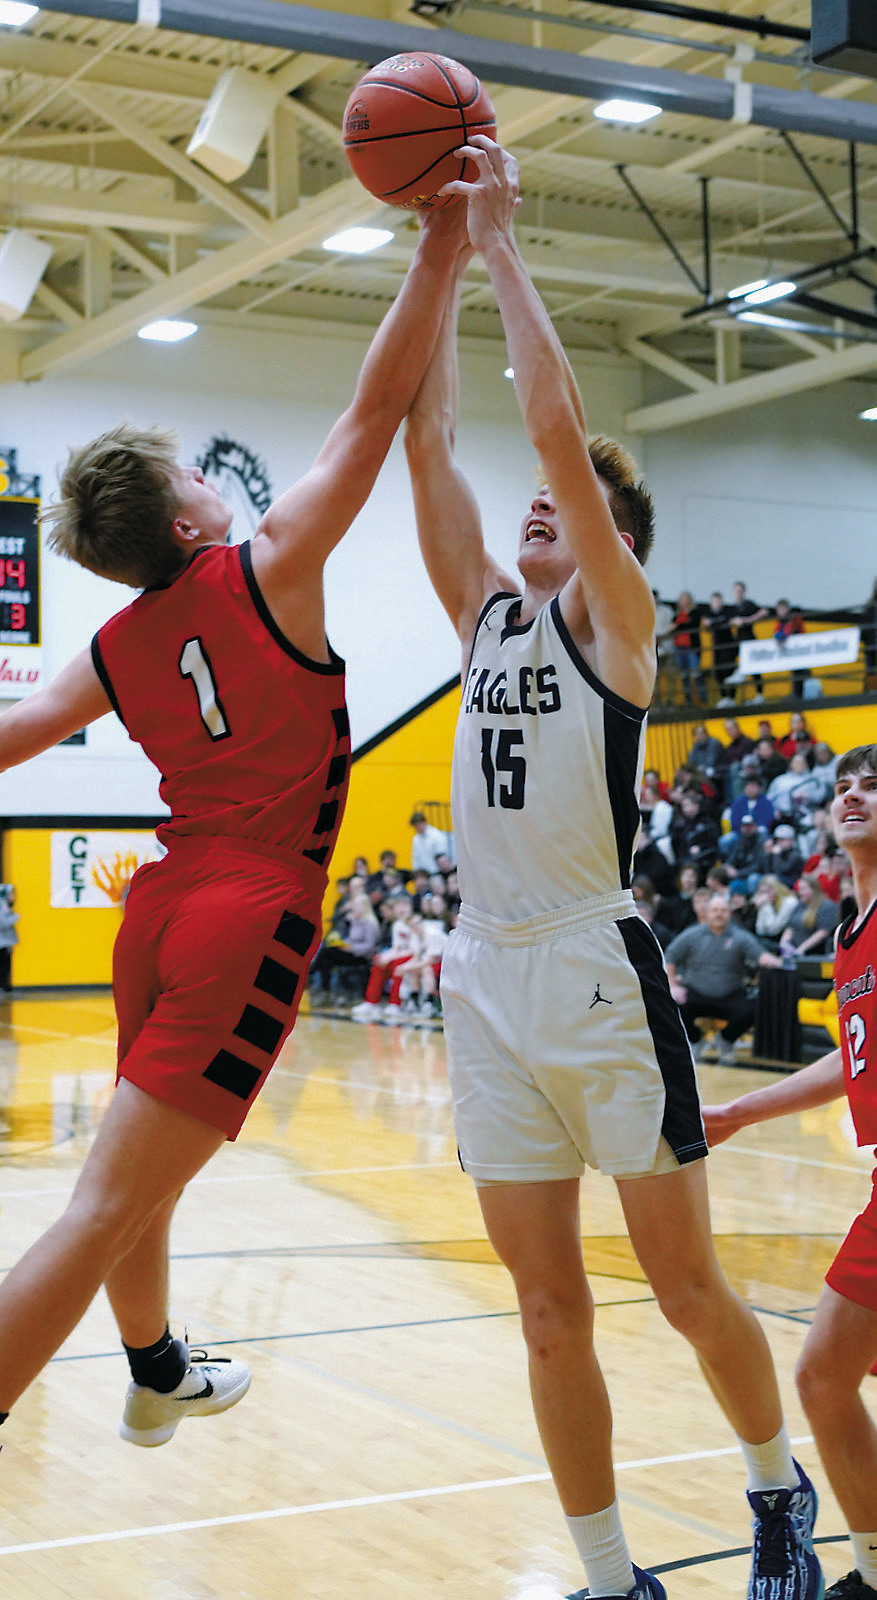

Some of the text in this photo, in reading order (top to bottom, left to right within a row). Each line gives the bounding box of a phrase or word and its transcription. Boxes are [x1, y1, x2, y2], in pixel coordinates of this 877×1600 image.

[10, 603, 26, 629] 3
[178, 635, 232, 742] 1
[481, 728, 527, 810] 15
[844, 1012, 866, 1080] 12
